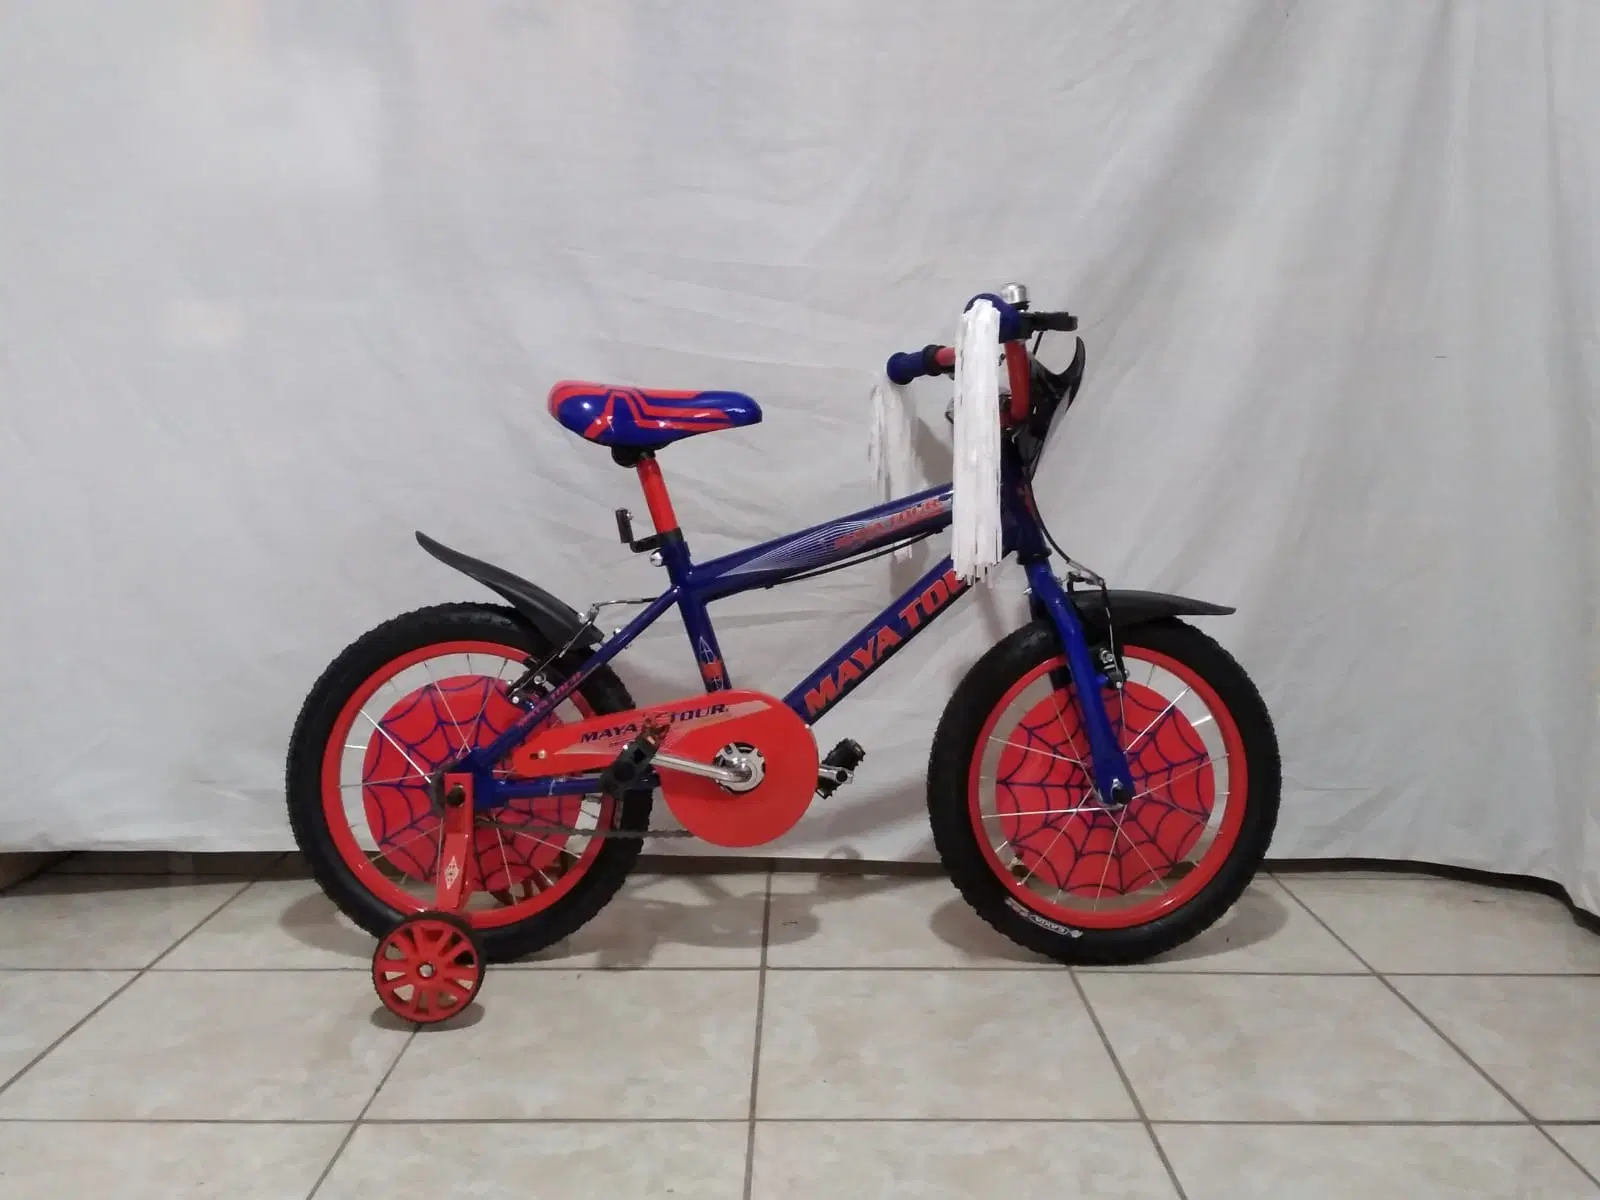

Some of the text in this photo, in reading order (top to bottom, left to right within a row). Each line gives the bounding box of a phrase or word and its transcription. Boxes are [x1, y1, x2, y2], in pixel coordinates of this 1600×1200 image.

[803, 568, 967, 716] MAYA TOU
[581, 723, 638, 743] MAYA
[669, 703, 727, 723] TOUR
